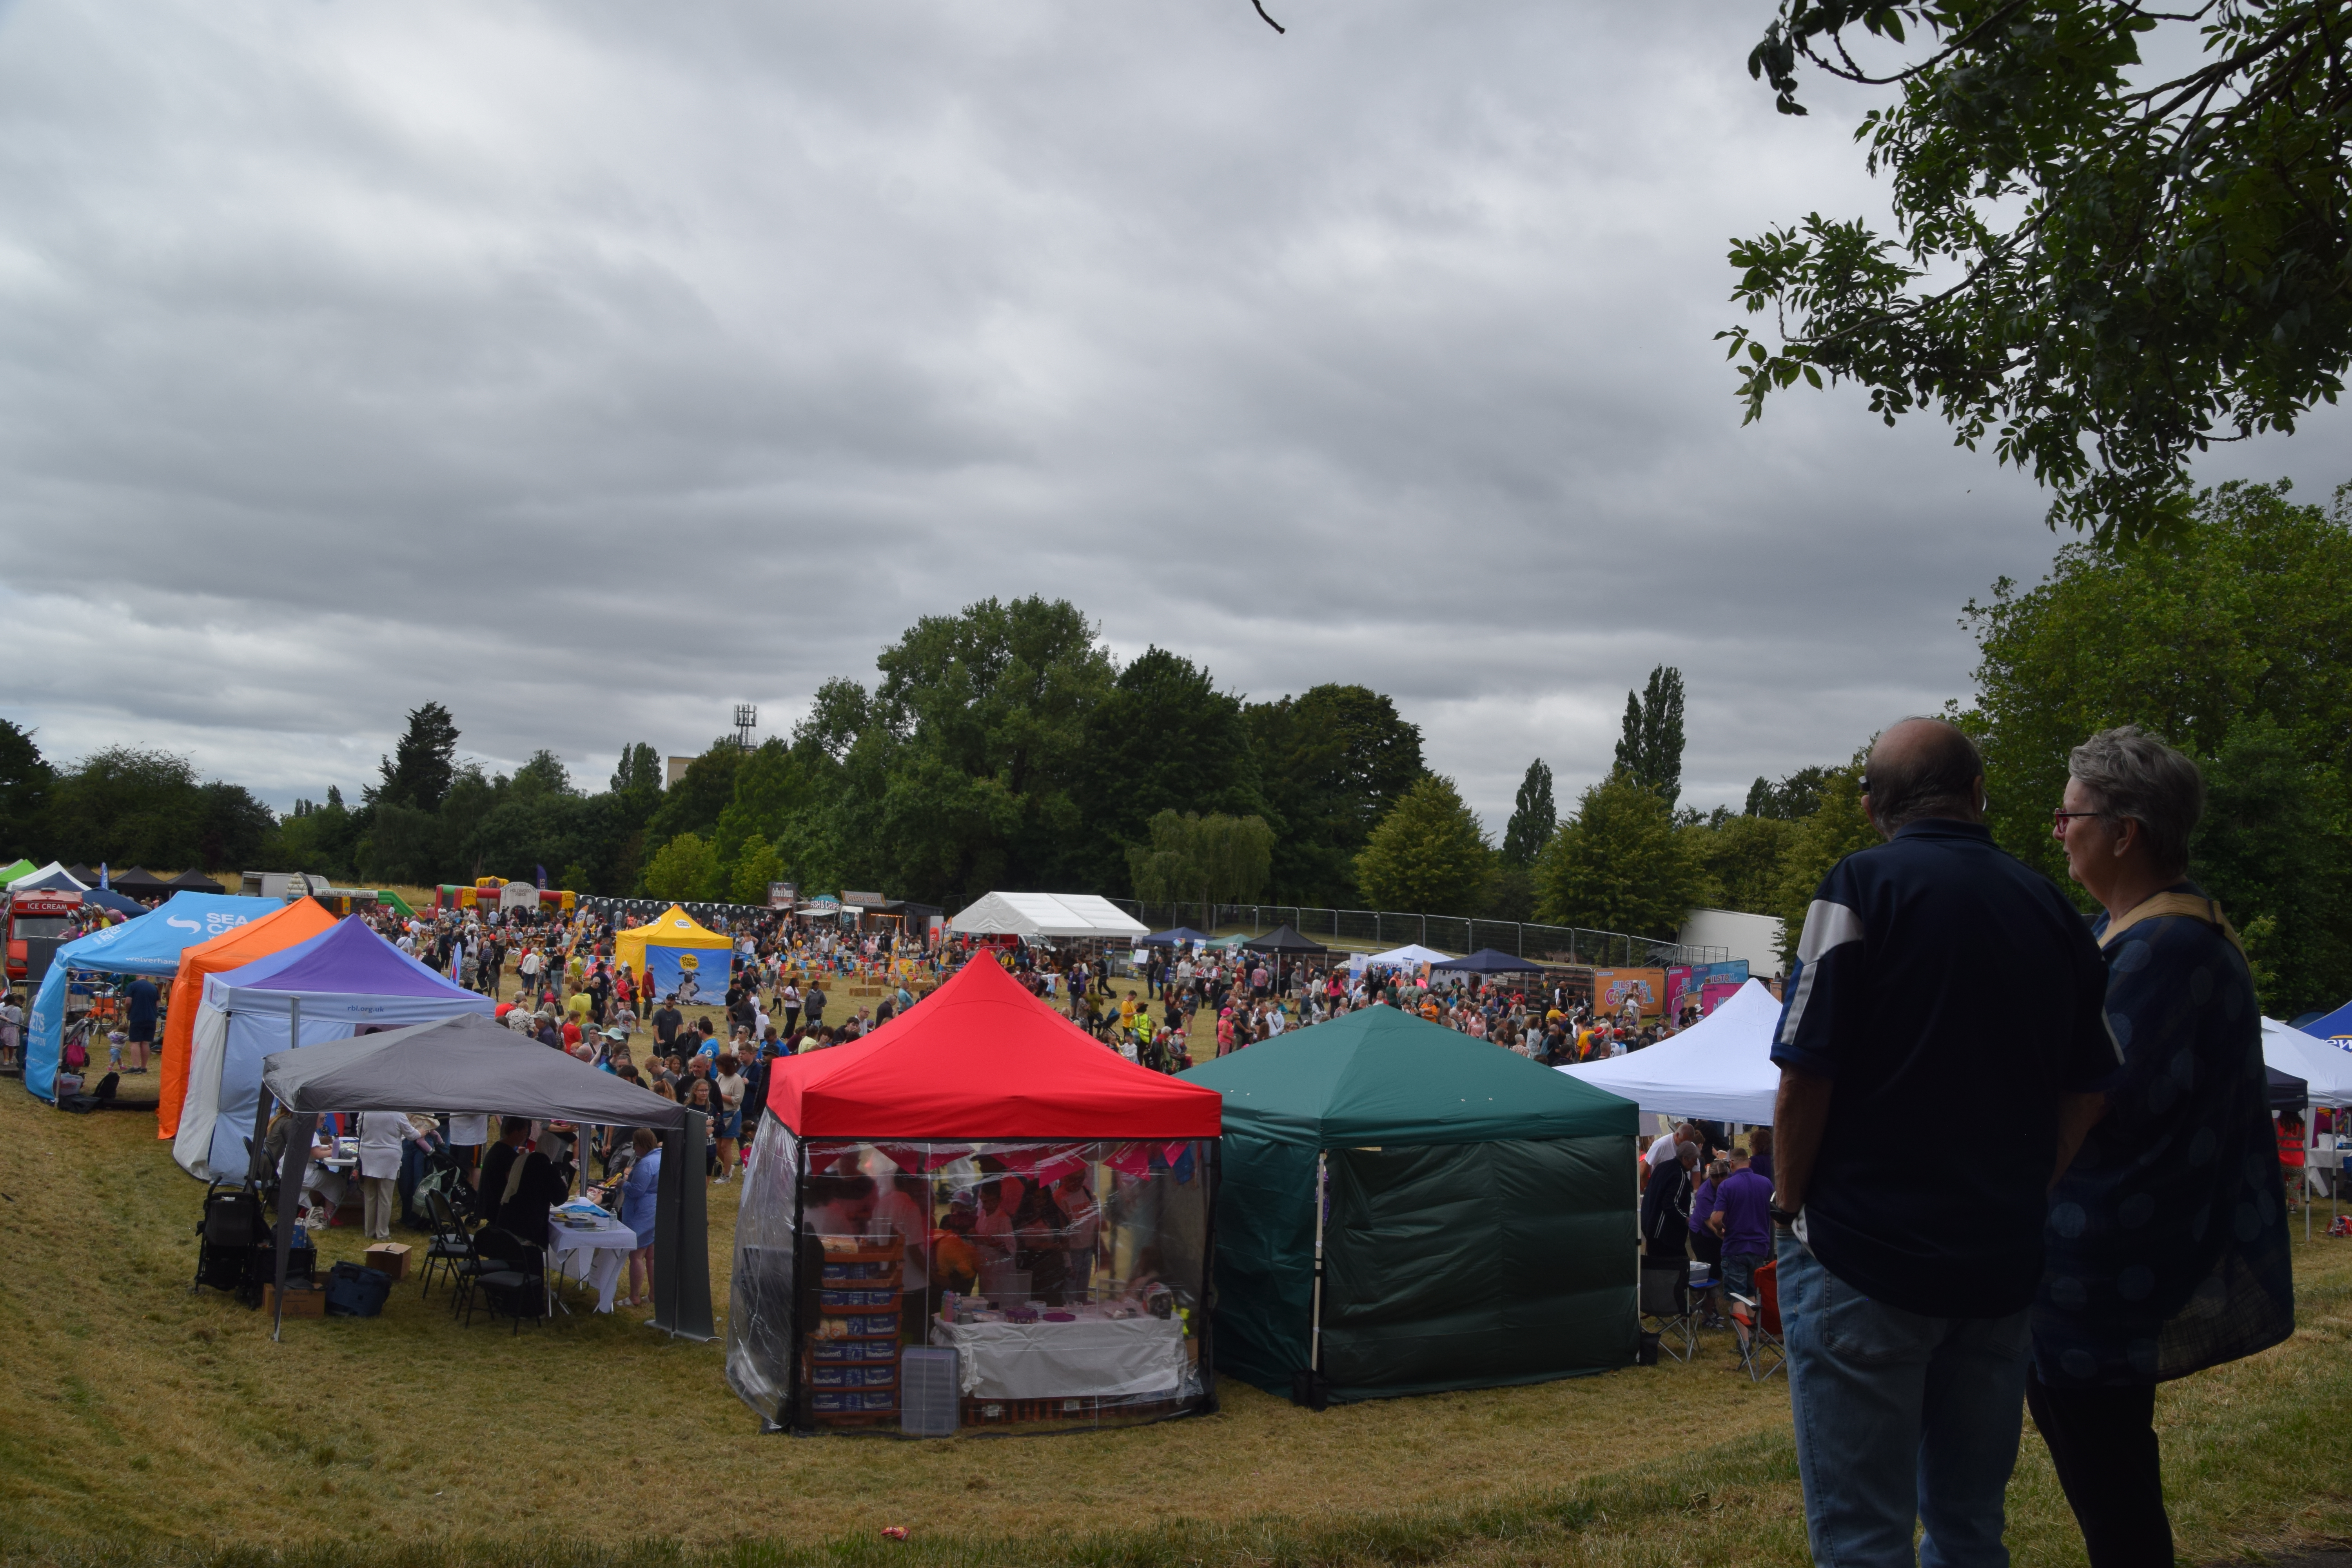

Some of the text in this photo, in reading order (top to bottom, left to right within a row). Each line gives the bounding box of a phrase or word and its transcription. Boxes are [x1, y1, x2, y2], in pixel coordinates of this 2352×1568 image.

[772, 887, 781, 897] Coffee
[820, 900, 824, 909] &
[825, 901, 839, 910] CHIPS
[206, 913, 248, 926] SEA
[348, 1005, 384, 1013] rbl.org.uk
[865, 1376, 893, 1384] Warburtons
[864, 1400, 892, 1408] Warburtons
